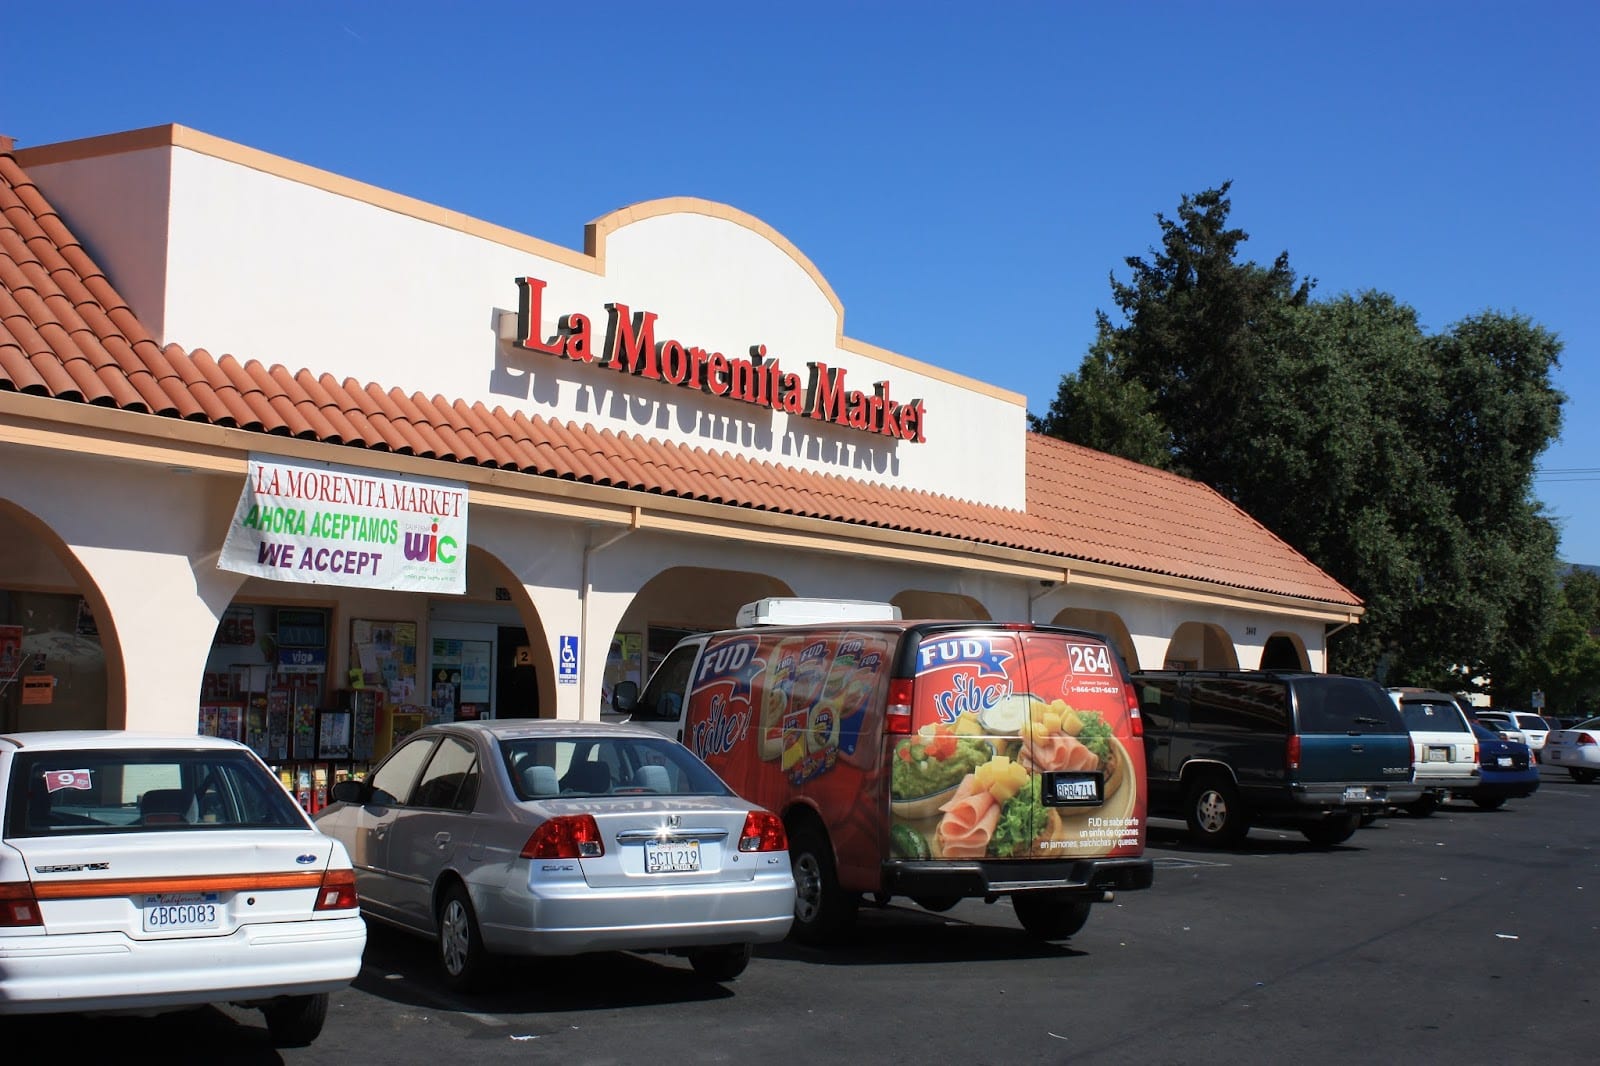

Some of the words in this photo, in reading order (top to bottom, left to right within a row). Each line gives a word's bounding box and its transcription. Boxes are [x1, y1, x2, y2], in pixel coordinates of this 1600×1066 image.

[515, 276, 593, 363] La
[602, 302, 803, 415] Morenita
[804, 361, 927, 444] Market
[254, 466, 281, 496] LA
[285, 469, 388, 509] MORENITA
[391, 483, 463, 518] MARKET
[243, 503, 305, 537] AHORA
[309, 511, 398, 545] ACEPTAMOS
[257, 541, 295, 568] WE
[299, 546, 383, 576] ACCEPT
[521, 651, 529, 662] 2
[698, 642, 750, 682] FUD
[801, 644, 825, 663] FUD
[920, 640, 983, 666] FUD
[1071, 646, 1110, 673] 264
[58, 773, 74, 785] 9
[1088, 817, 1102, 827] FUD
[1040, 841, 1049, 849] en
[150, 904, 216, 926] 6BCG083
